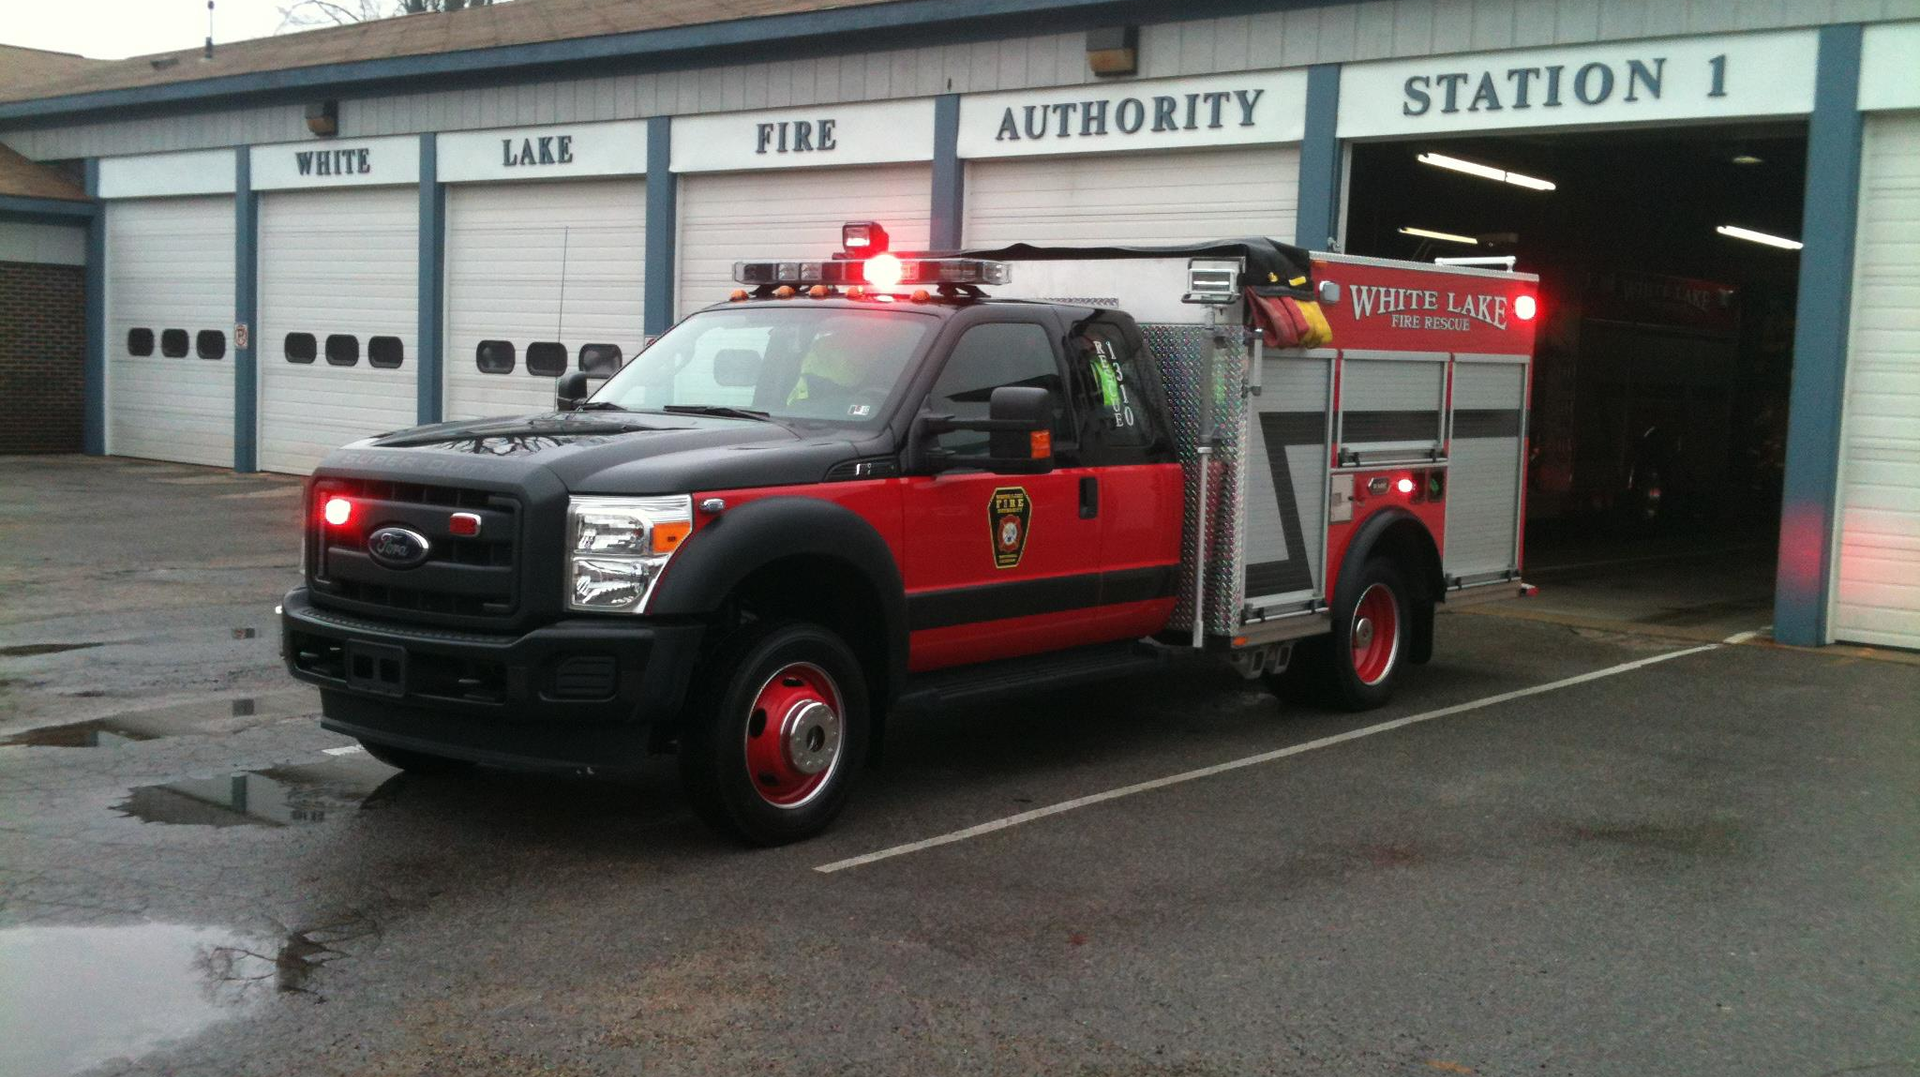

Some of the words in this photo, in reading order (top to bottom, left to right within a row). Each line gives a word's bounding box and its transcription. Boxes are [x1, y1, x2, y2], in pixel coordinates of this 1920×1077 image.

[1402, 58, 1666, 117] STATION
[1706, 54, 1728, 98] 1
[996, 89, 1264, 141] AUTHORITY
[502, 135, 574, 167] LAKE
[755, 119, 838, 153] FIRE
[295, 148, 371, 176] WHITE
[1350, 284, 1439, 321] WHITE
[1447, 292, 1508, 330] LAKE
[1391, 314, 1421, 329] FIRE
[1424, 316, 1471, 332] RESCUE
[996, 498, 1024, 509] FIRE
